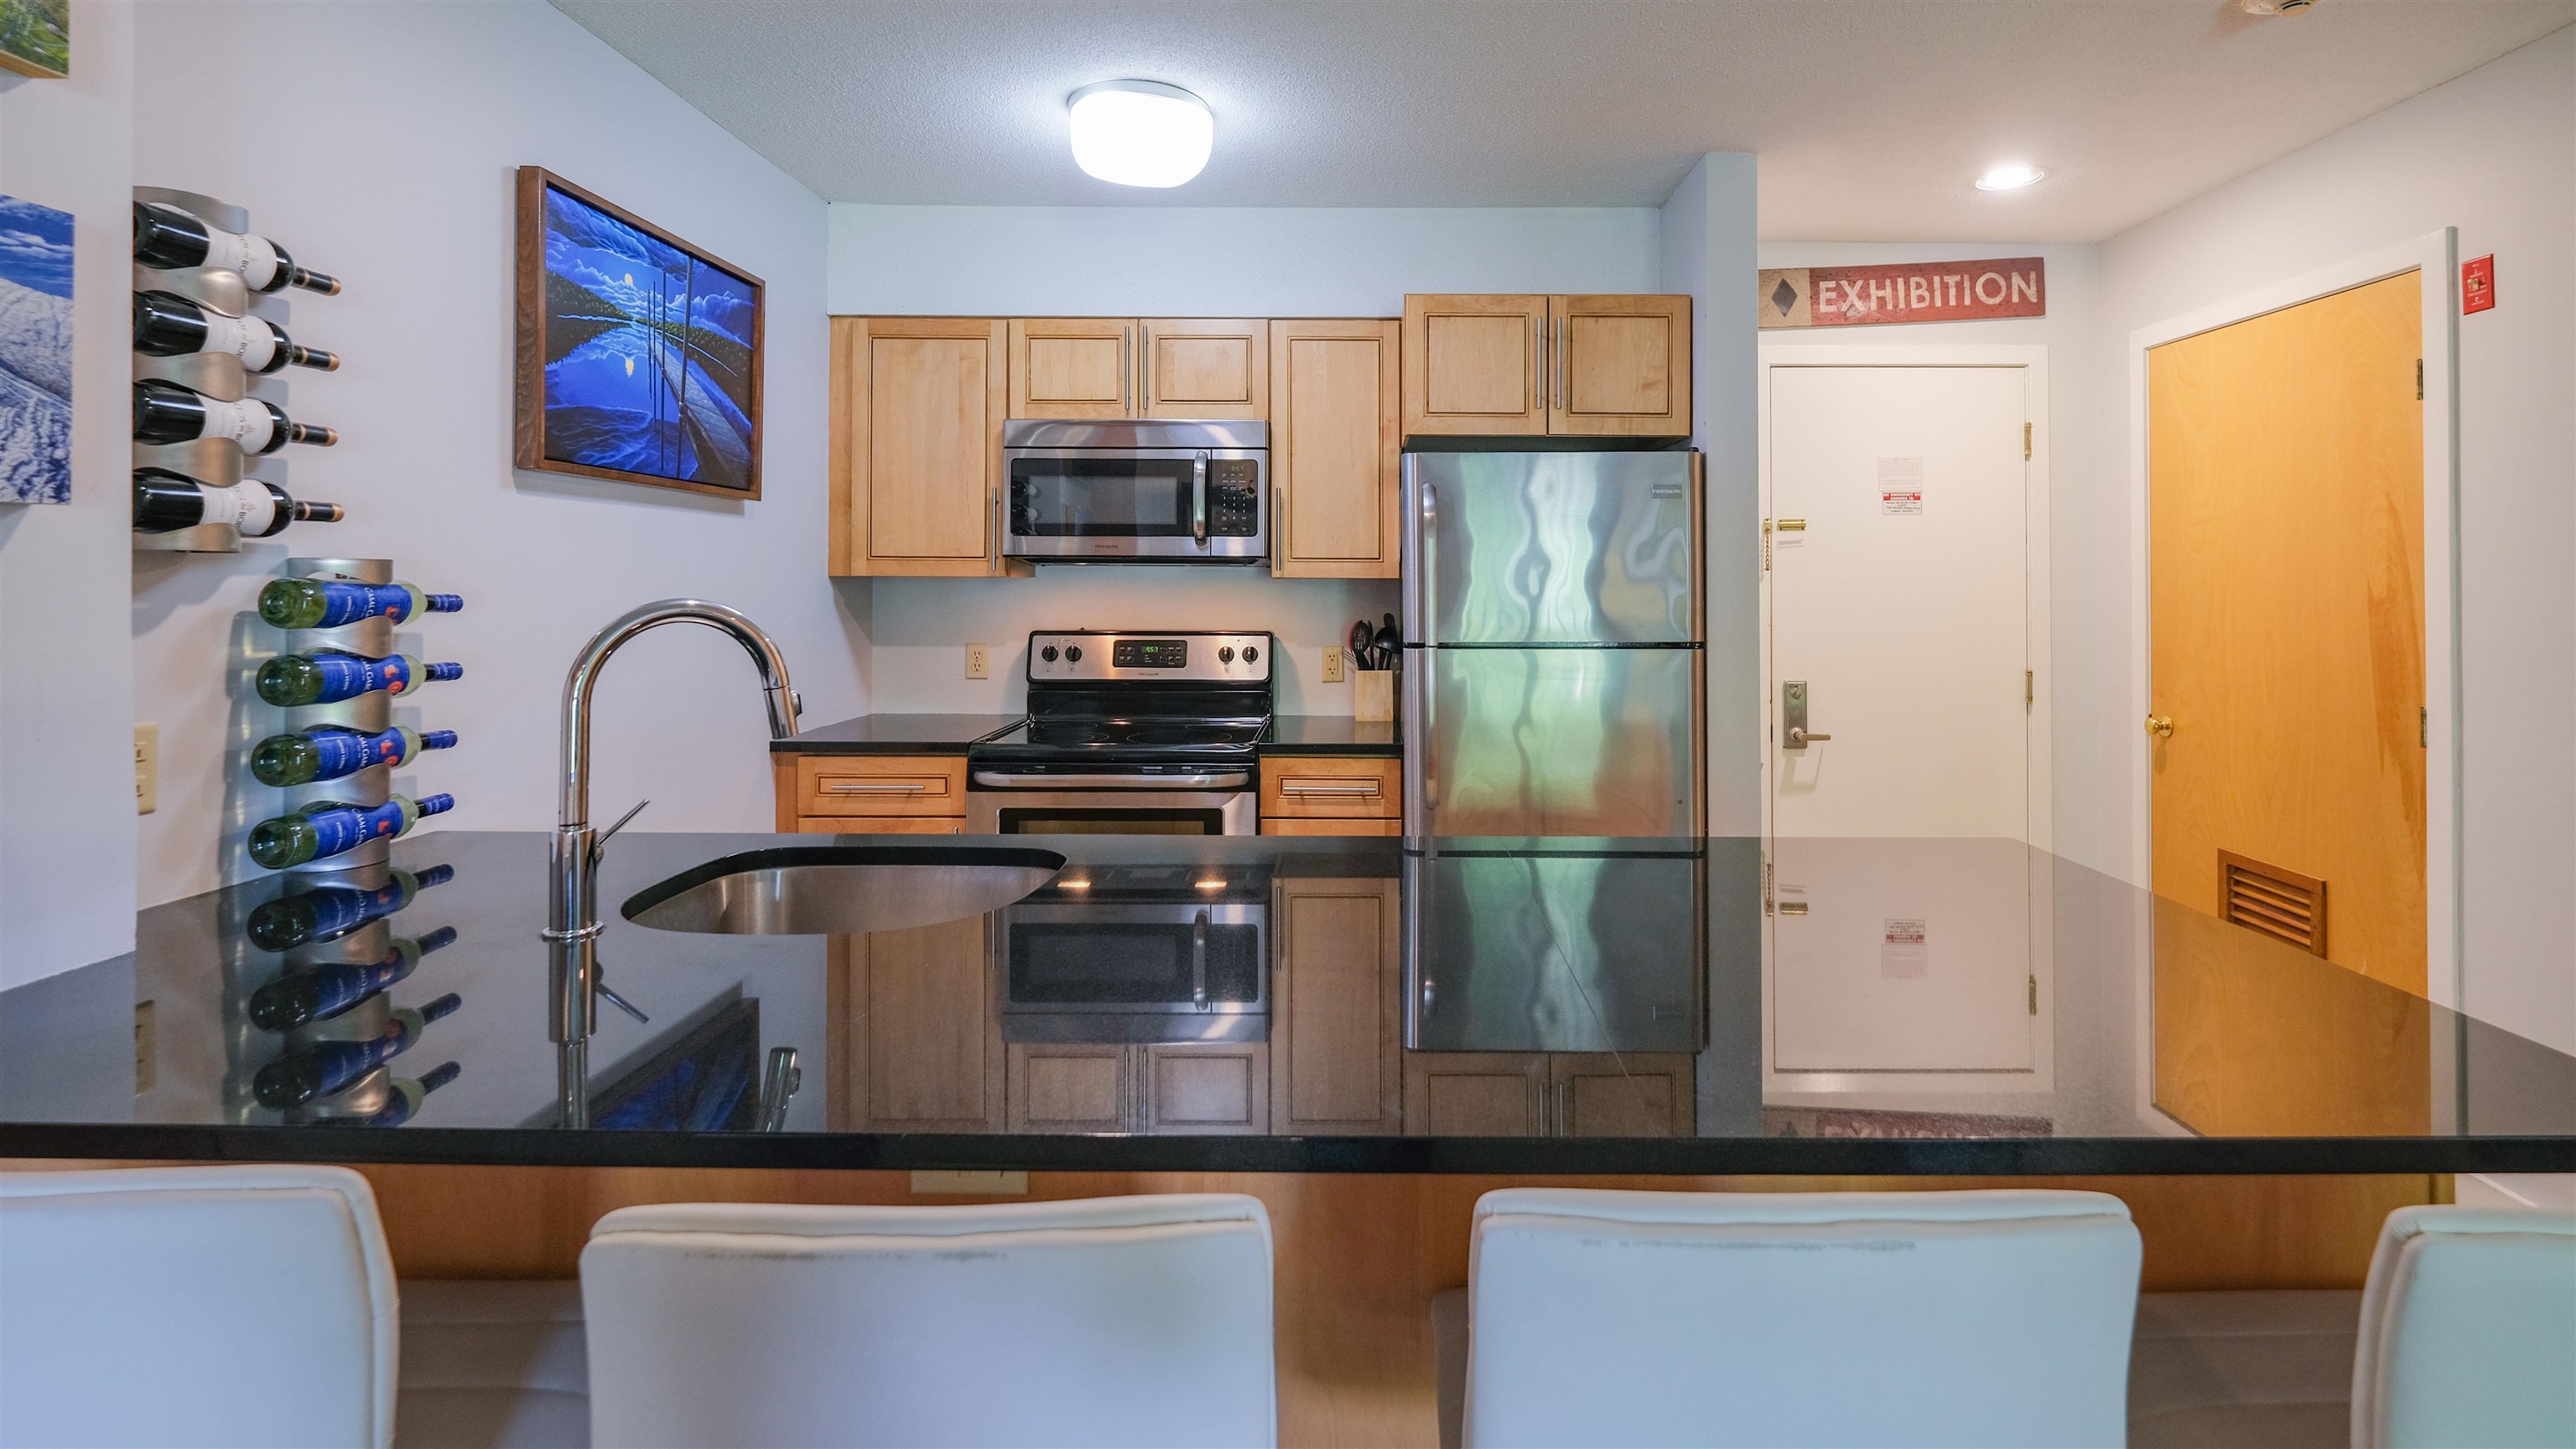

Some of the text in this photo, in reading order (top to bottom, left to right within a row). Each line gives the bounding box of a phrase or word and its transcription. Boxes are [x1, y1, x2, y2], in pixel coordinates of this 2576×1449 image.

[1819, 271, 2038, 315] EXHIBITION
[364, 587, 376, 610] CASAL
[351, 808, 366, 829] CASAL
